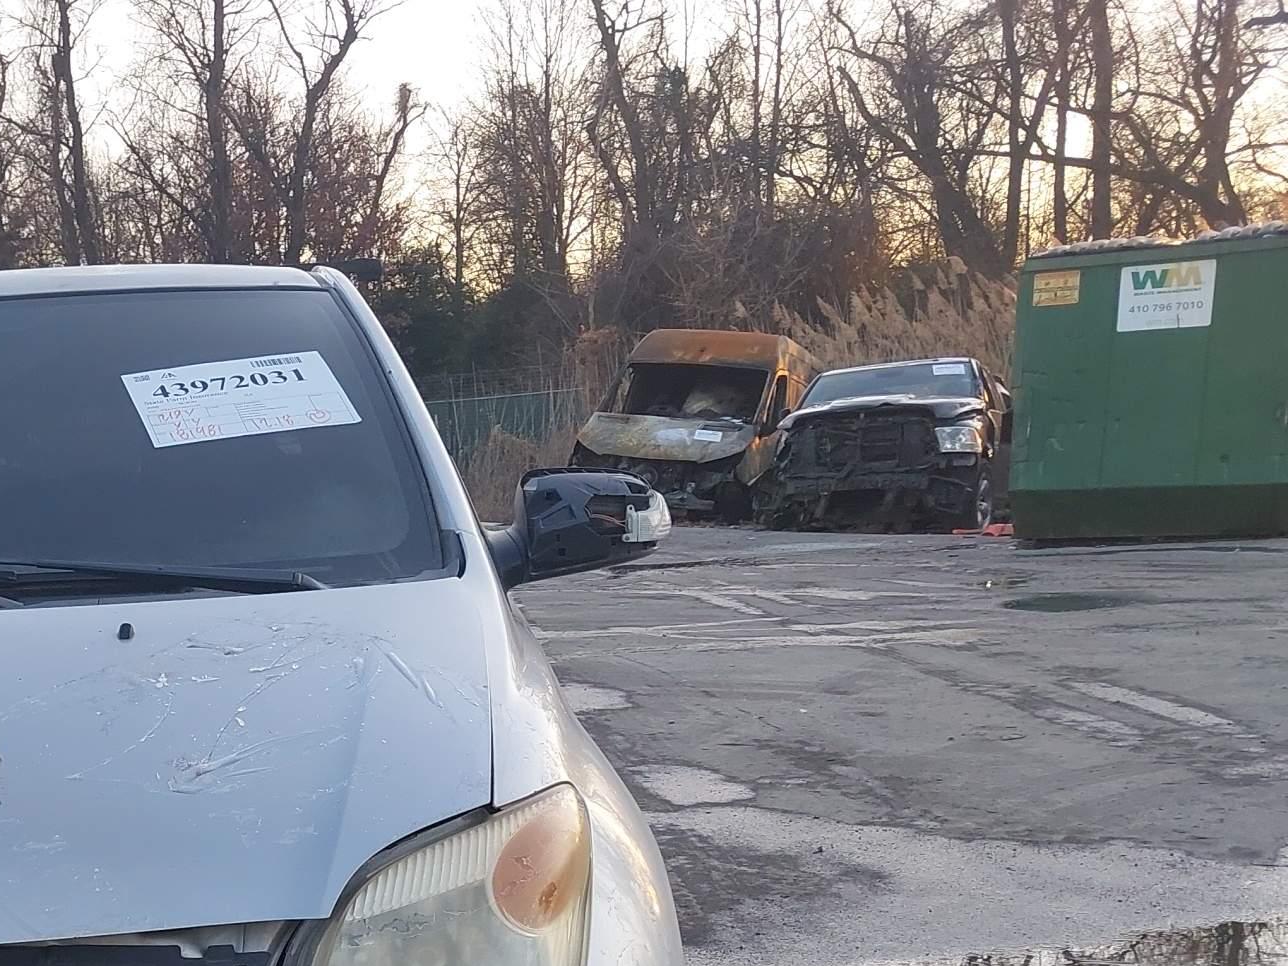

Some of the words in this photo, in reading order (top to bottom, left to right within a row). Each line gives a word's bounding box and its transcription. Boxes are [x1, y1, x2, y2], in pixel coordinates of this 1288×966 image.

[1131, 266, 1202, 290] WM
[1128, 304, 1150, 314] 410
[1152, 302, 1173, 313] 796
[1175, 300, 1204, 311] 7010
[152, 368, 308, 399] 43972031
